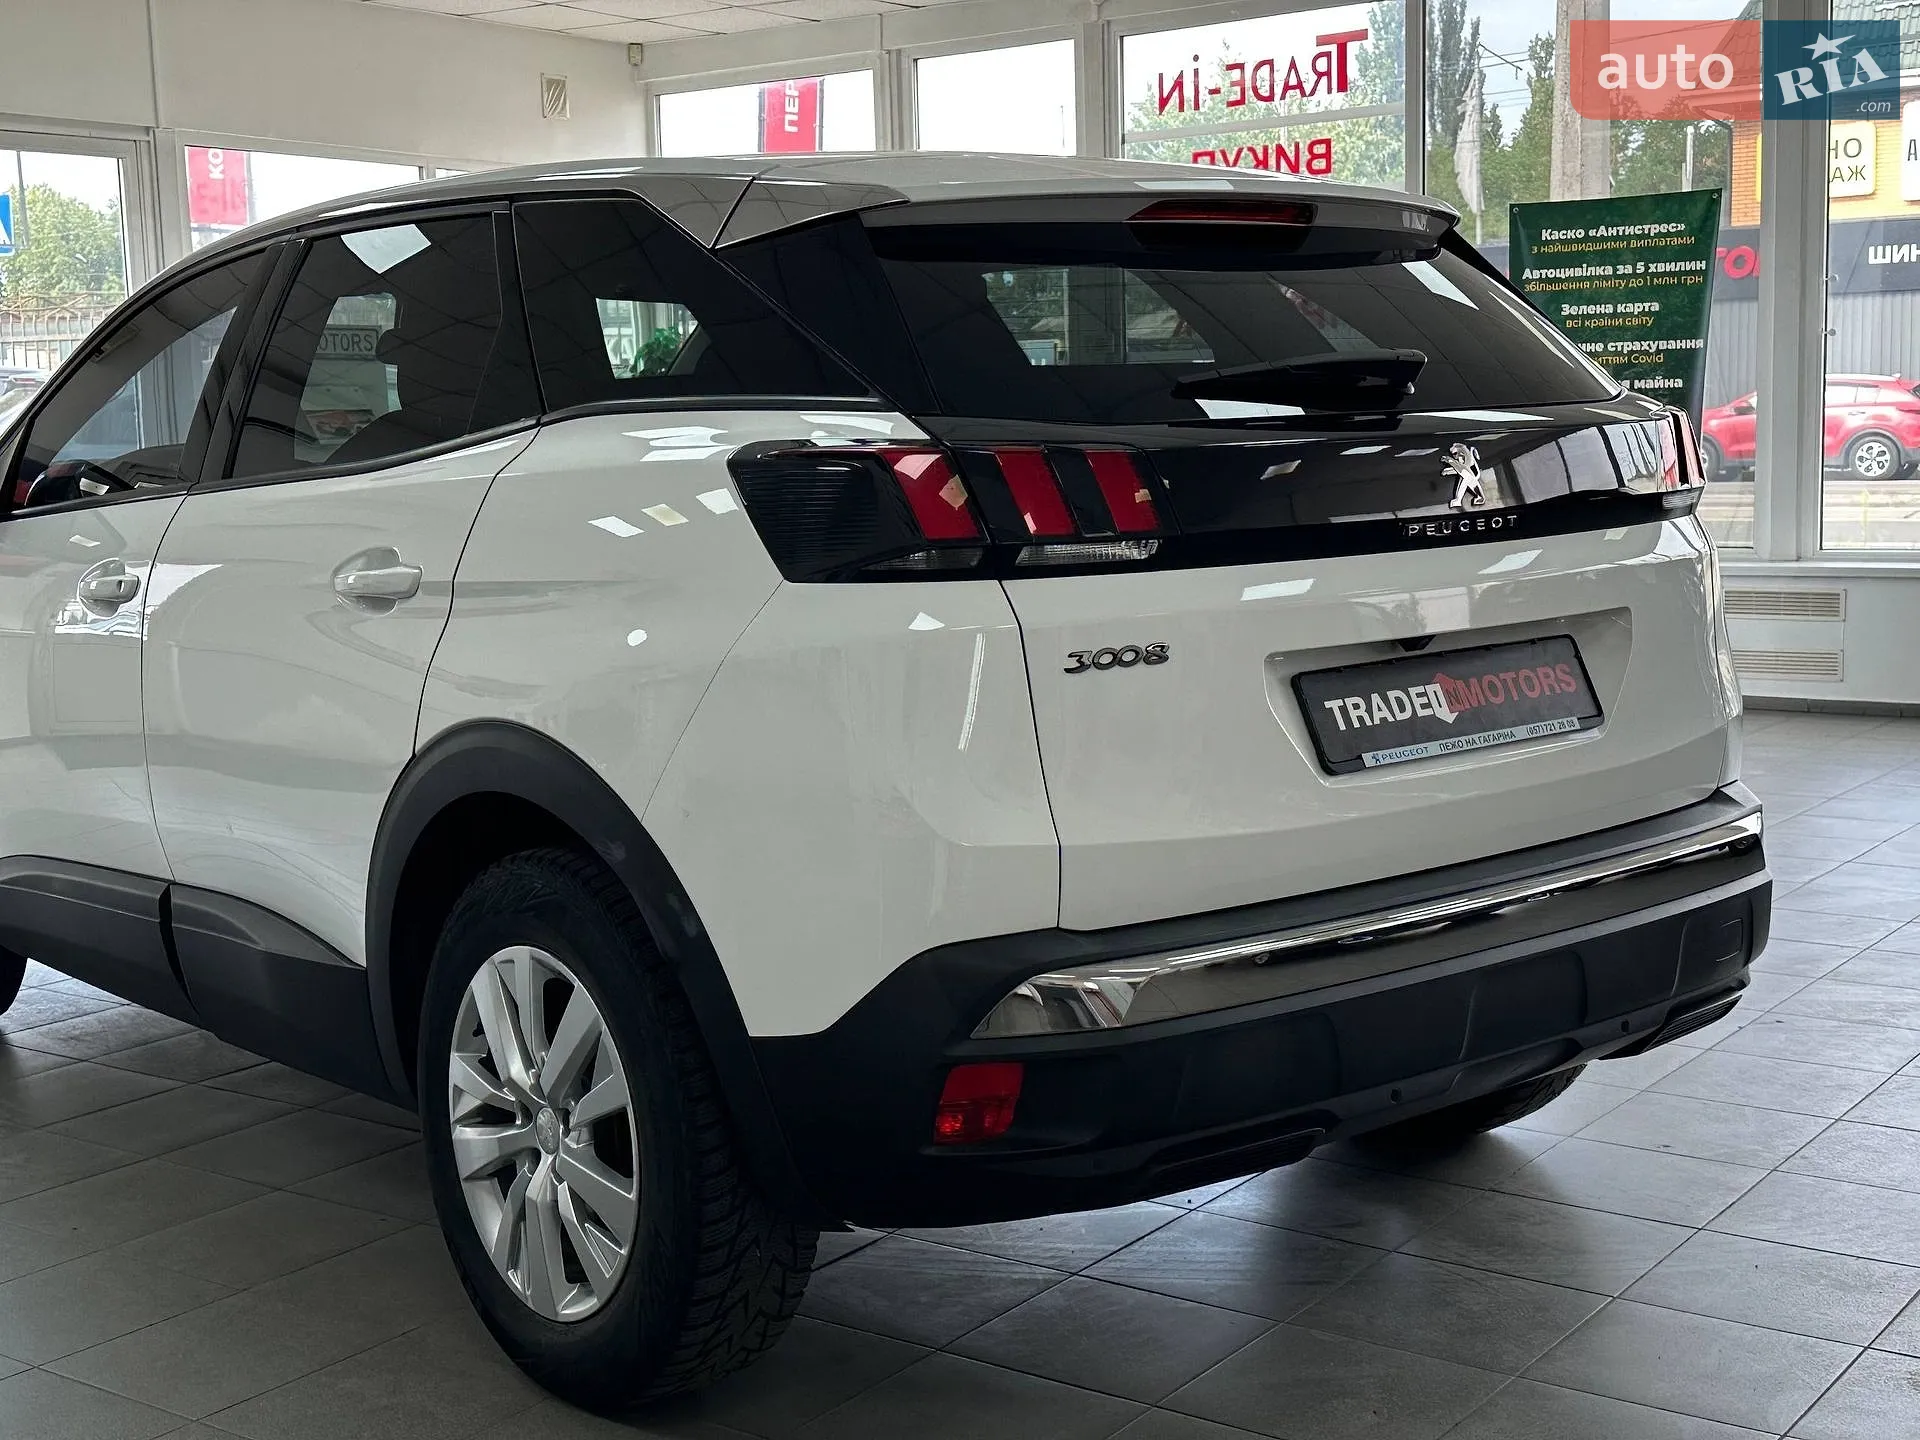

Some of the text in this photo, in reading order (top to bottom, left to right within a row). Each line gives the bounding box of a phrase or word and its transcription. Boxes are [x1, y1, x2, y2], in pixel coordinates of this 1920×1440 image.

[1541, 222, 1686, 241] Каско «Антистрес»
[1540, 240, 1627, 253] найшвидшими
[1630, 236, 1695, 248] виплатами
[1521, 260, 1707, 280] Автоцивілка за 5 хвилин
[1524, 281, 1590, 292] збільшення
[1592, 277, 1626, 289] ліміту
[1628, 278, 1644, 287] до
[1653, 276, 1678, 285] млн
[1681, 275, 1704, 285] грн
[1560, 301, 1660, 316] Зелена карта
[1566, 314, 1655, 329] всі країни світу
[1607, 338, 1704, 354] страхування
[1630, 353, 1664, 364] Covid
[1634, 377, 1683, 389] майна
[1408, 514, 1518, 537] PEUGEOT
[1063, 641, 1170, 674] 3008
[1381, 746, 1430, 761] PEUGEOT
